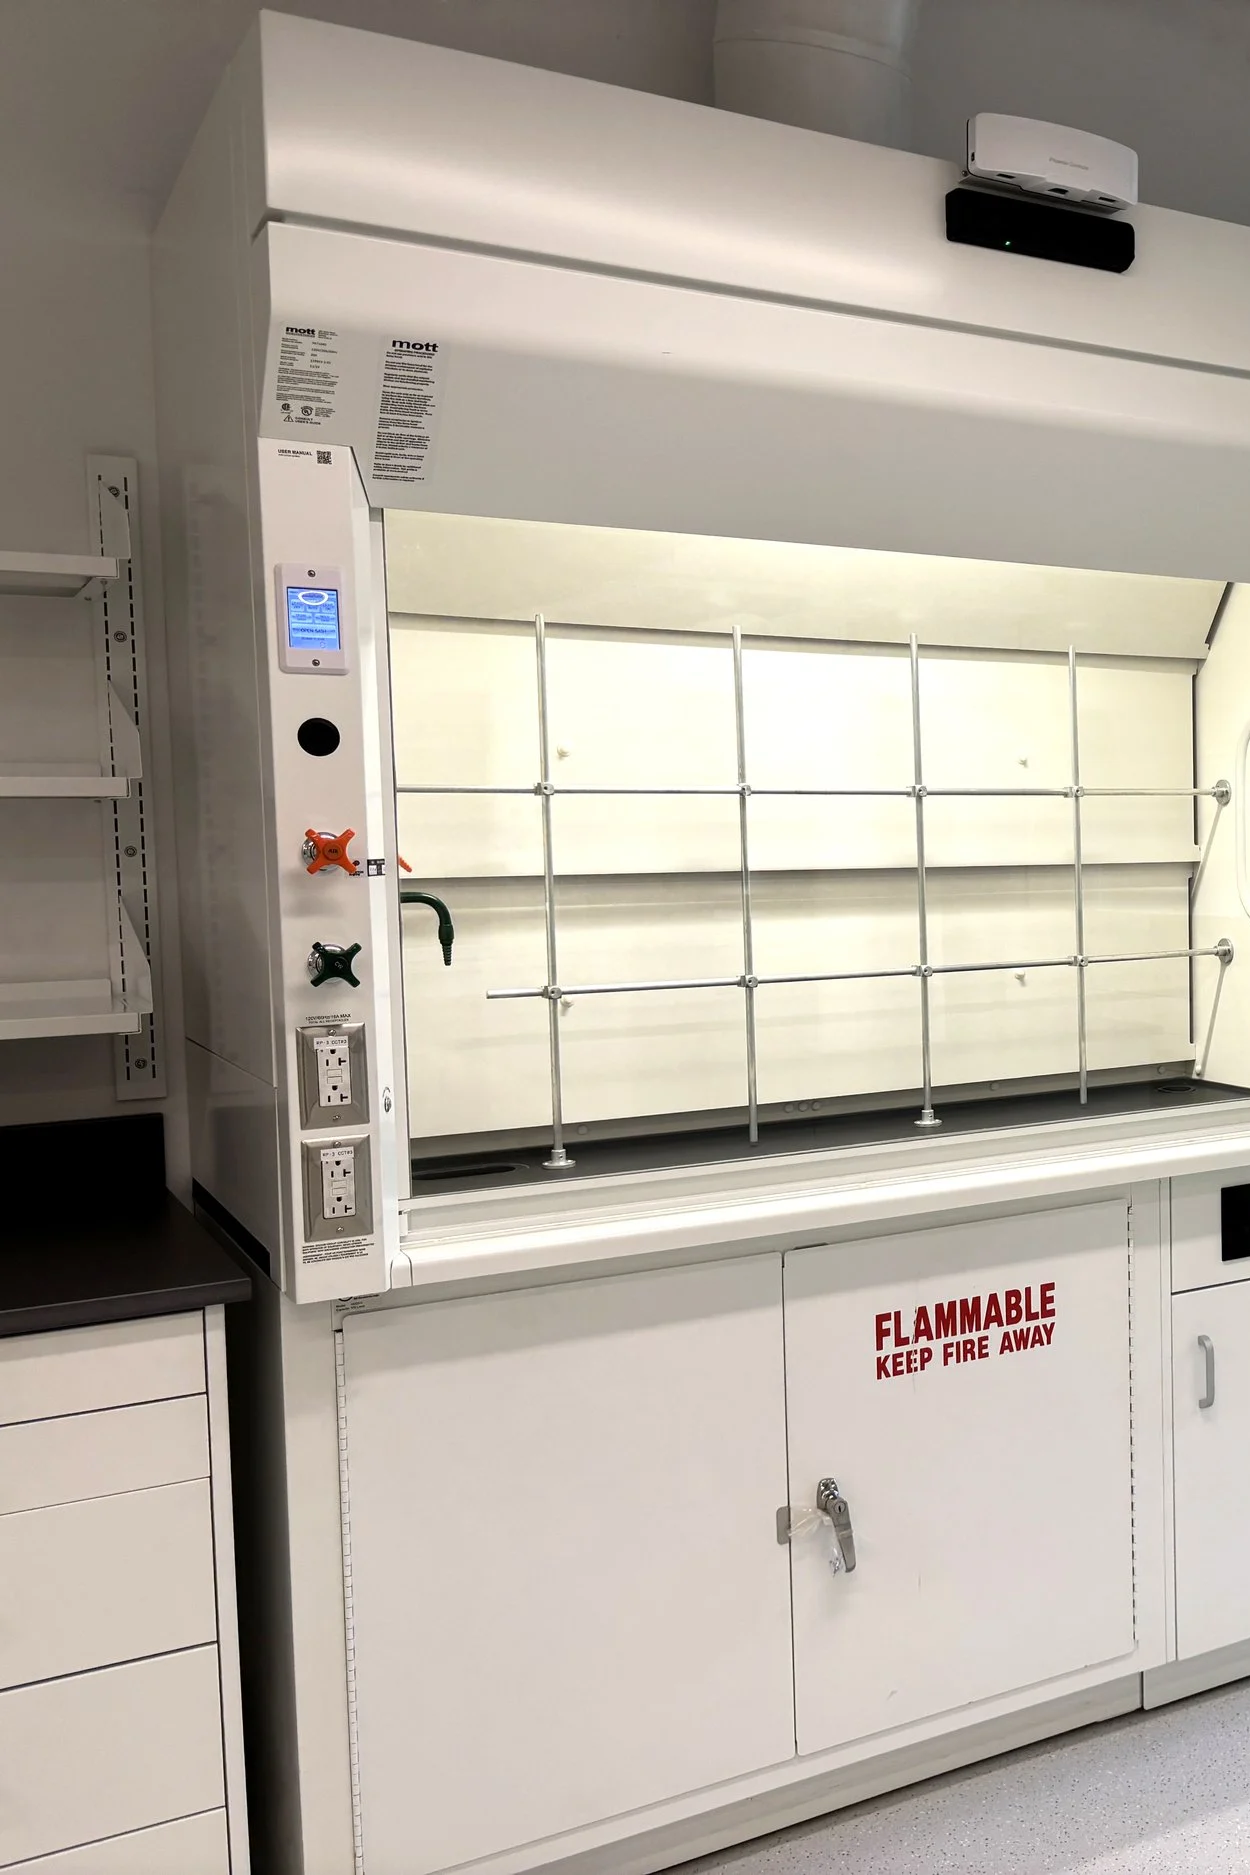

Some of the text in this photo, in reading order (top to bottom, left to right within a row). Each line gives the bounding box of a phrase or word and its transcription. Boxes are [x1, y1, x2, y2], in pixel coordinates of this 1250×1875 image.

[285, 326, 316, 336] mott
[391, 339, 439, 353] mott
[875, 1281, 1056, 1351] FLAMMABLE
[876, 1321, 1056, 1380] KEEP FIRE AWAY
